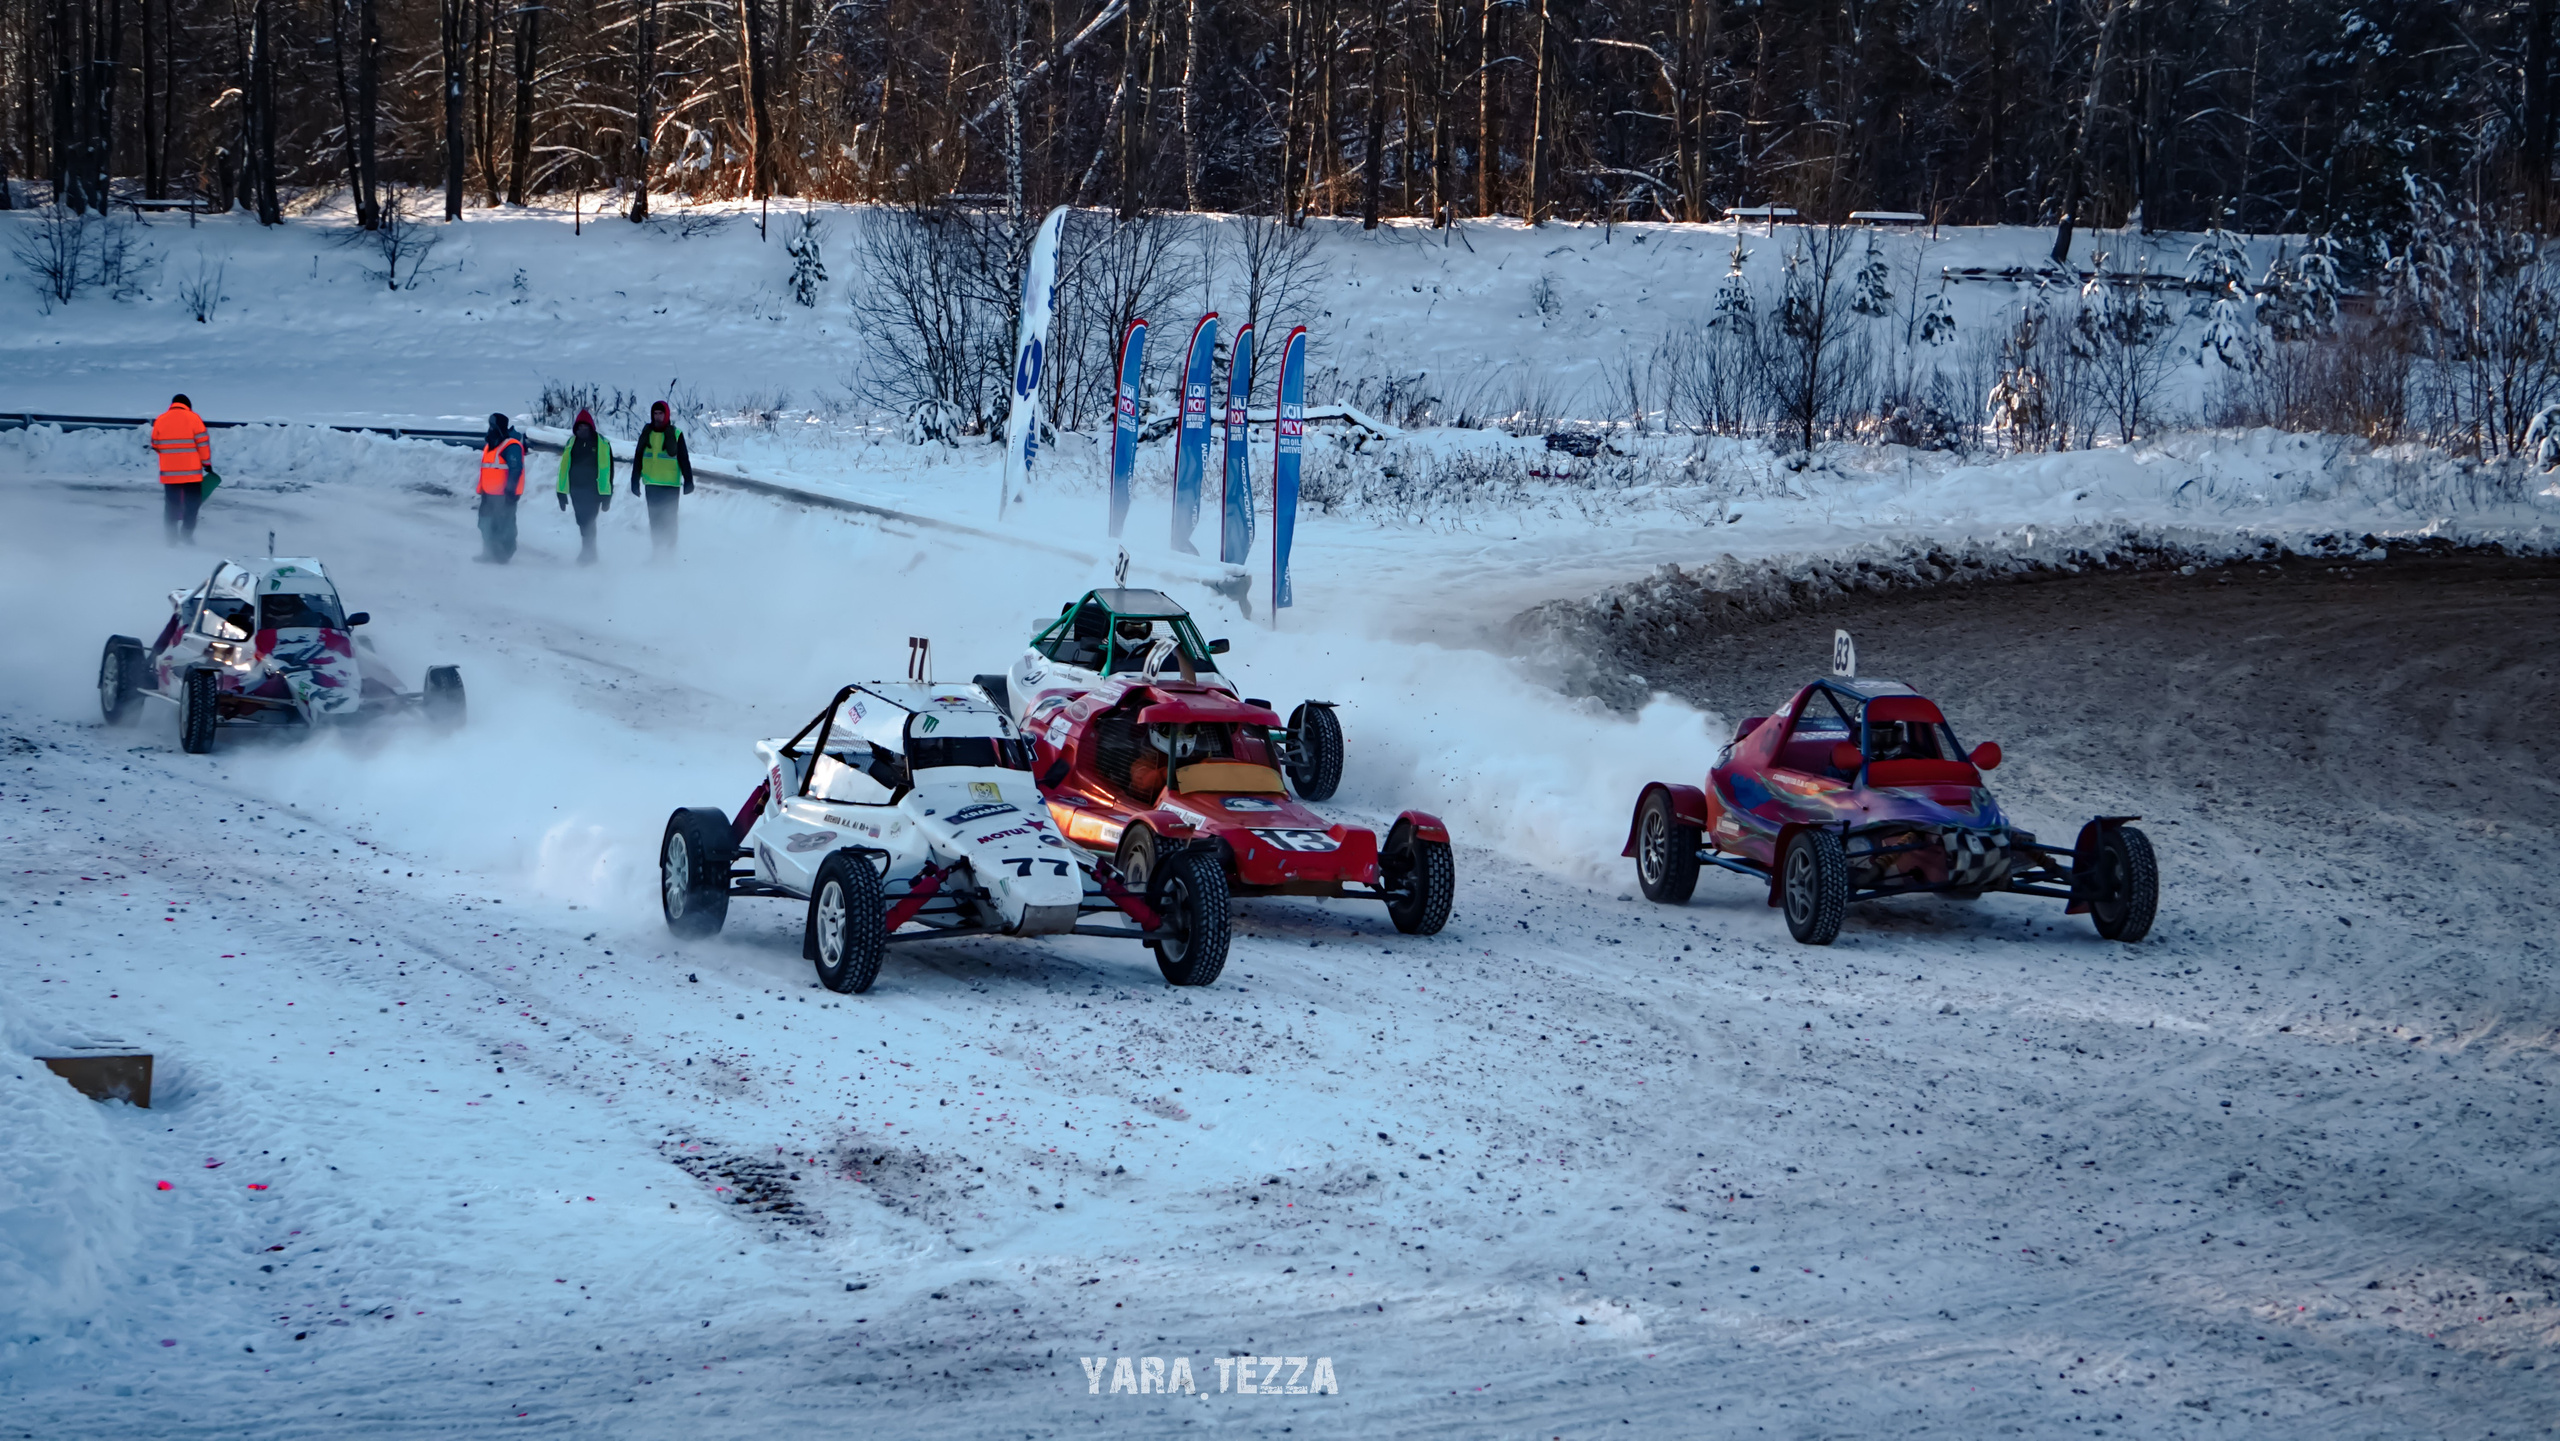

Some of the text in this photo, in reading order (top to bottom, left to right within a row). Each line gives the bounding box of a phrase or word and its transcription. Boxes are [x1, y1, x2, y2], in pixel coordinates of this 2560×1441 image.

[1115, 552, 1129, 582] 31
[908, 636, 928, 680] 77
[1147, 641, 1173, 677] 13
[1835, 637, 1849, 671] 83
[960, 804, 1014, 819] KRAMAR
[976, 827, 1031, 845] MOTUL
[1256, 830, 1341, 851] 13
[1001, 857, 1070, 878] 77
